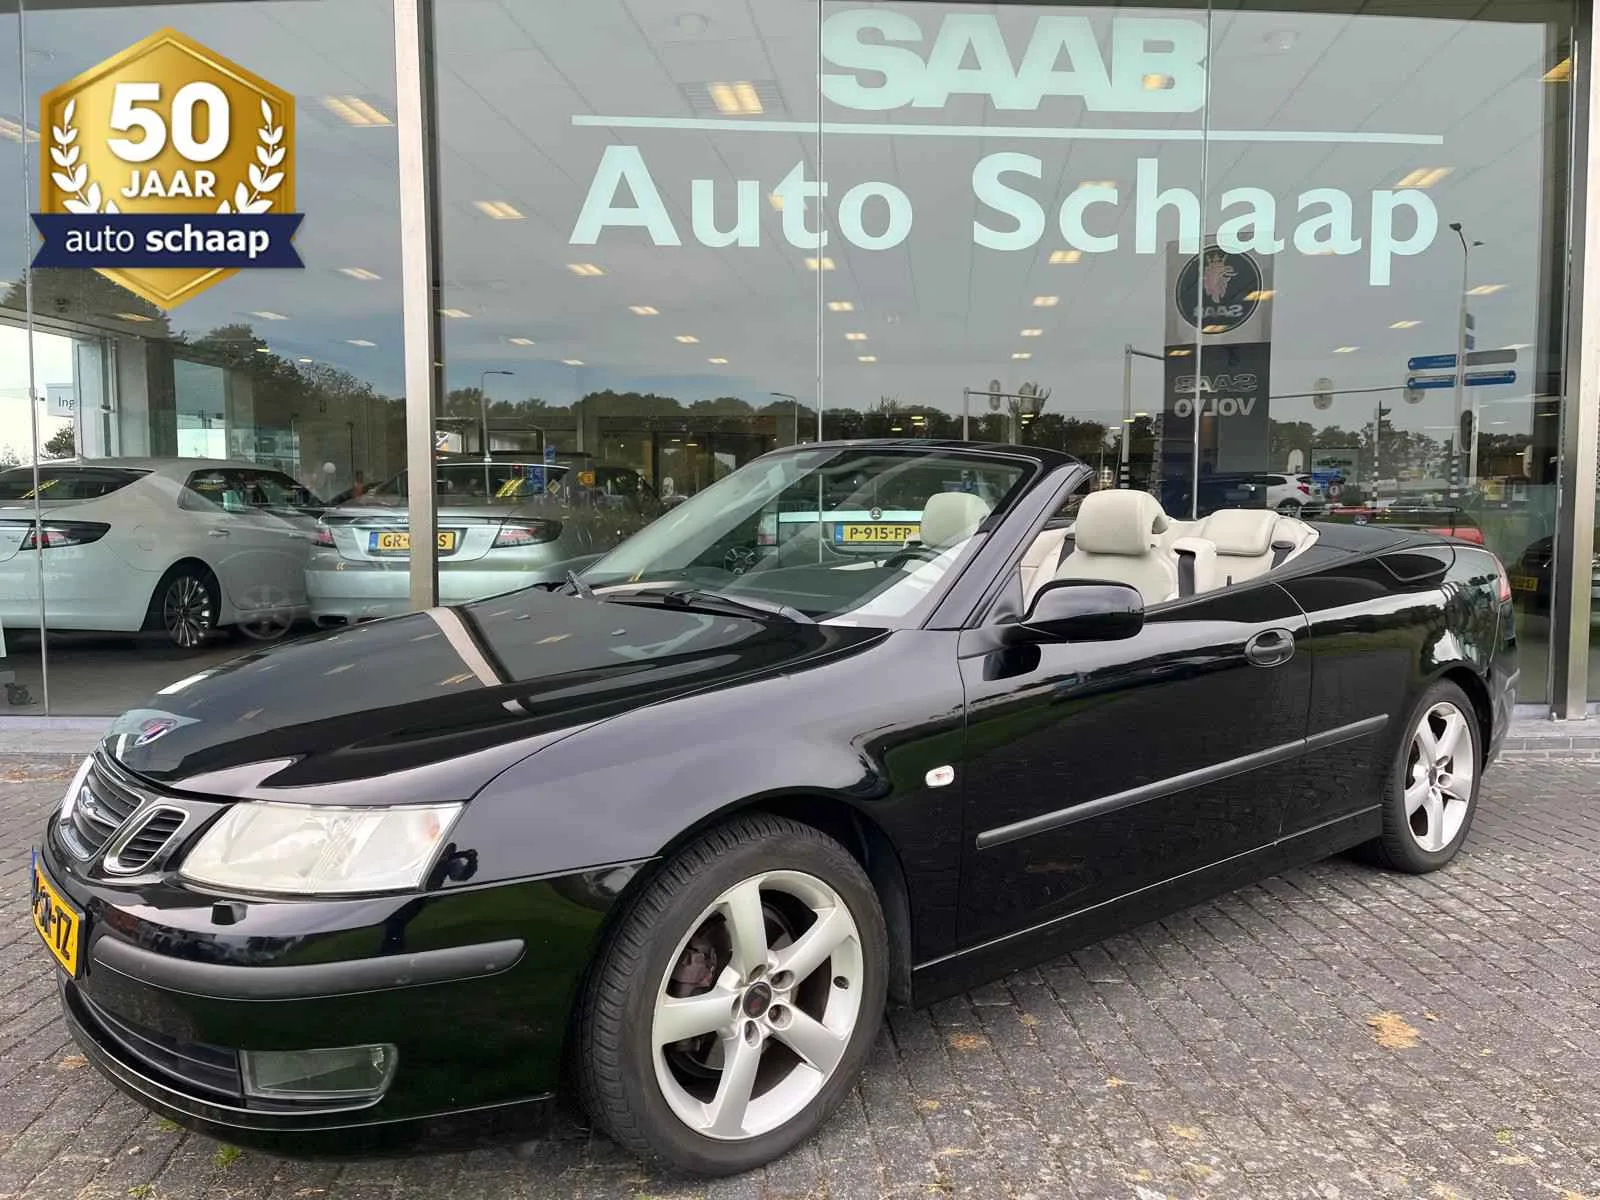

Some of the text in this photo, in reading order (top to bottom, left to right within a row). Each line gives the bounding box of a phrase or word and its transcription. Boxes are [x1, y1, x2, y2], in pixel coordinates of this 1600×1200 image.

[816, 8, 1208, 113] SAAB
[568, 145, 1439, 286] Auto Schaap
